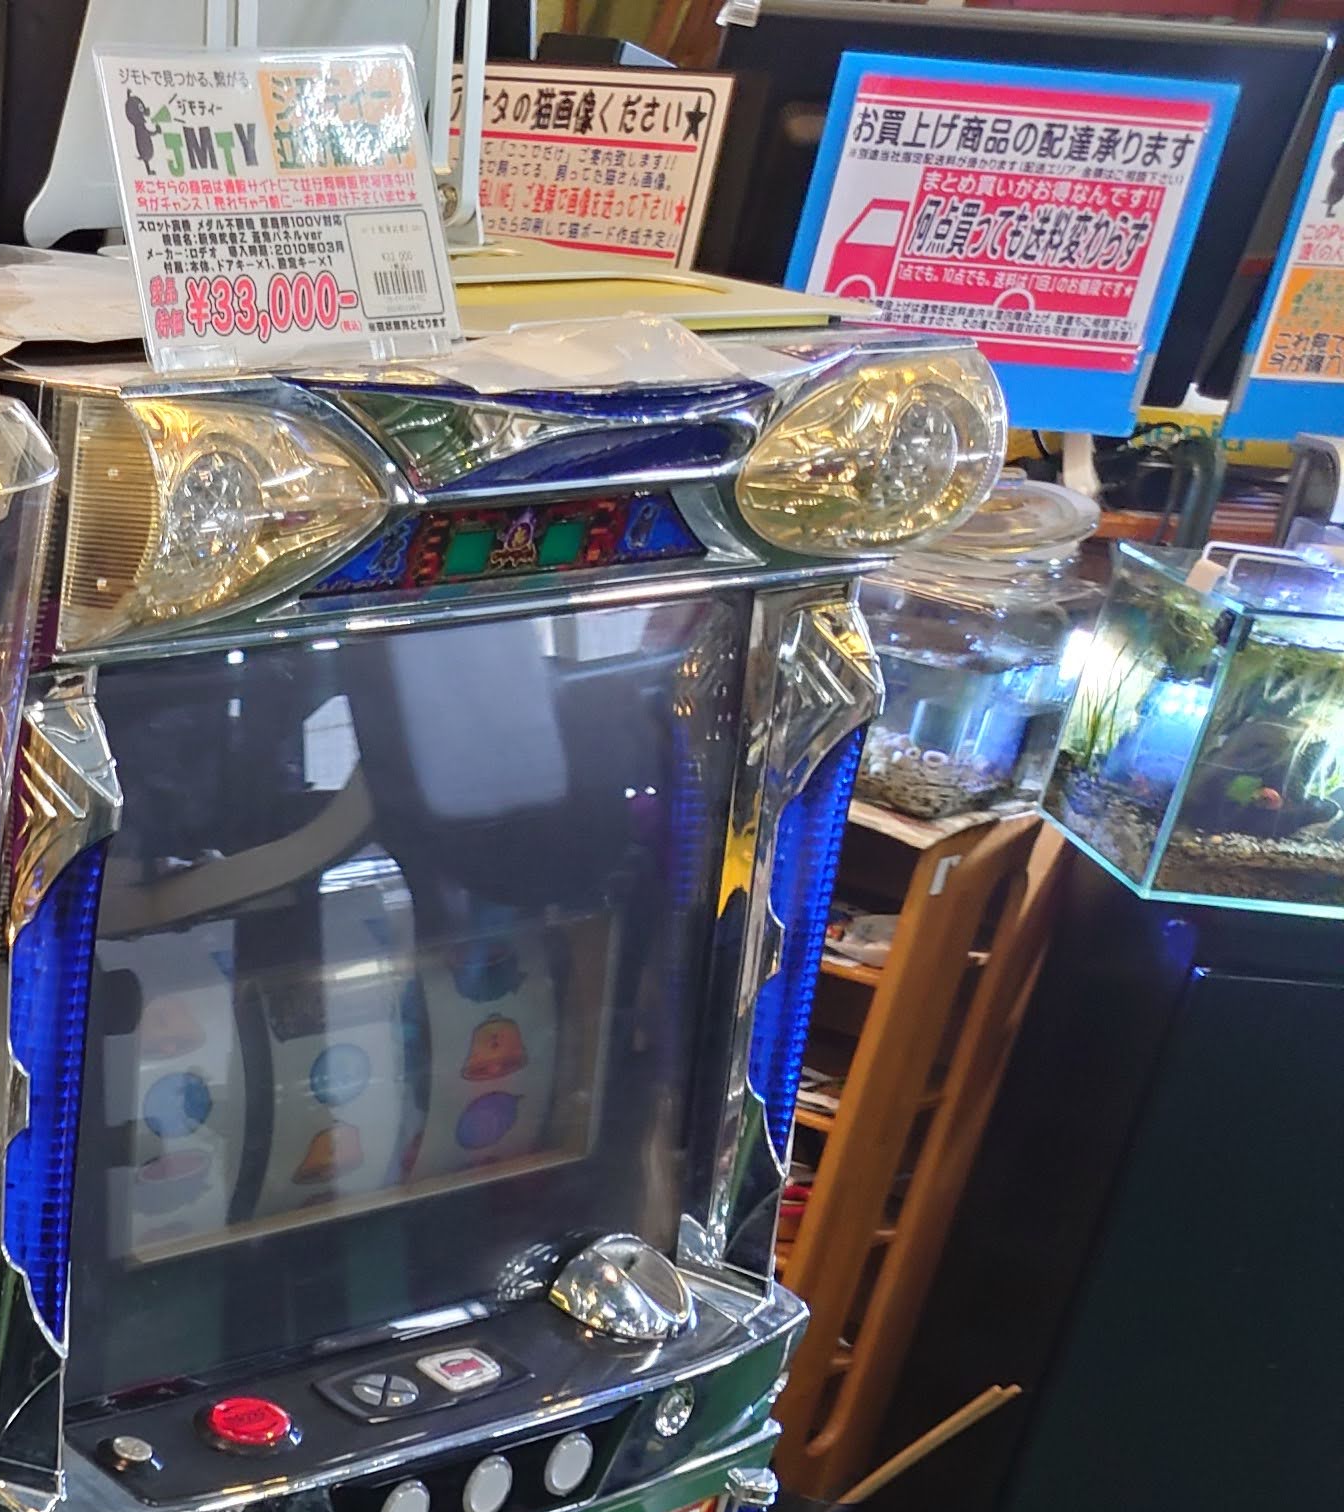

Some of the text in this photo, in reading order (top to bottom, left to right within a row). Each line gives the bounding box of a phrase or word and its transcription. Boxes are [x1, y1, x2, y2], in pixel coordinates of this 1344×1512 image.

[177, 100, 223, 116] ジモティー
[163, 123, 259, 177] JMTY
[853, 106, 1196, 170] お買上げ商品の配達承ります
